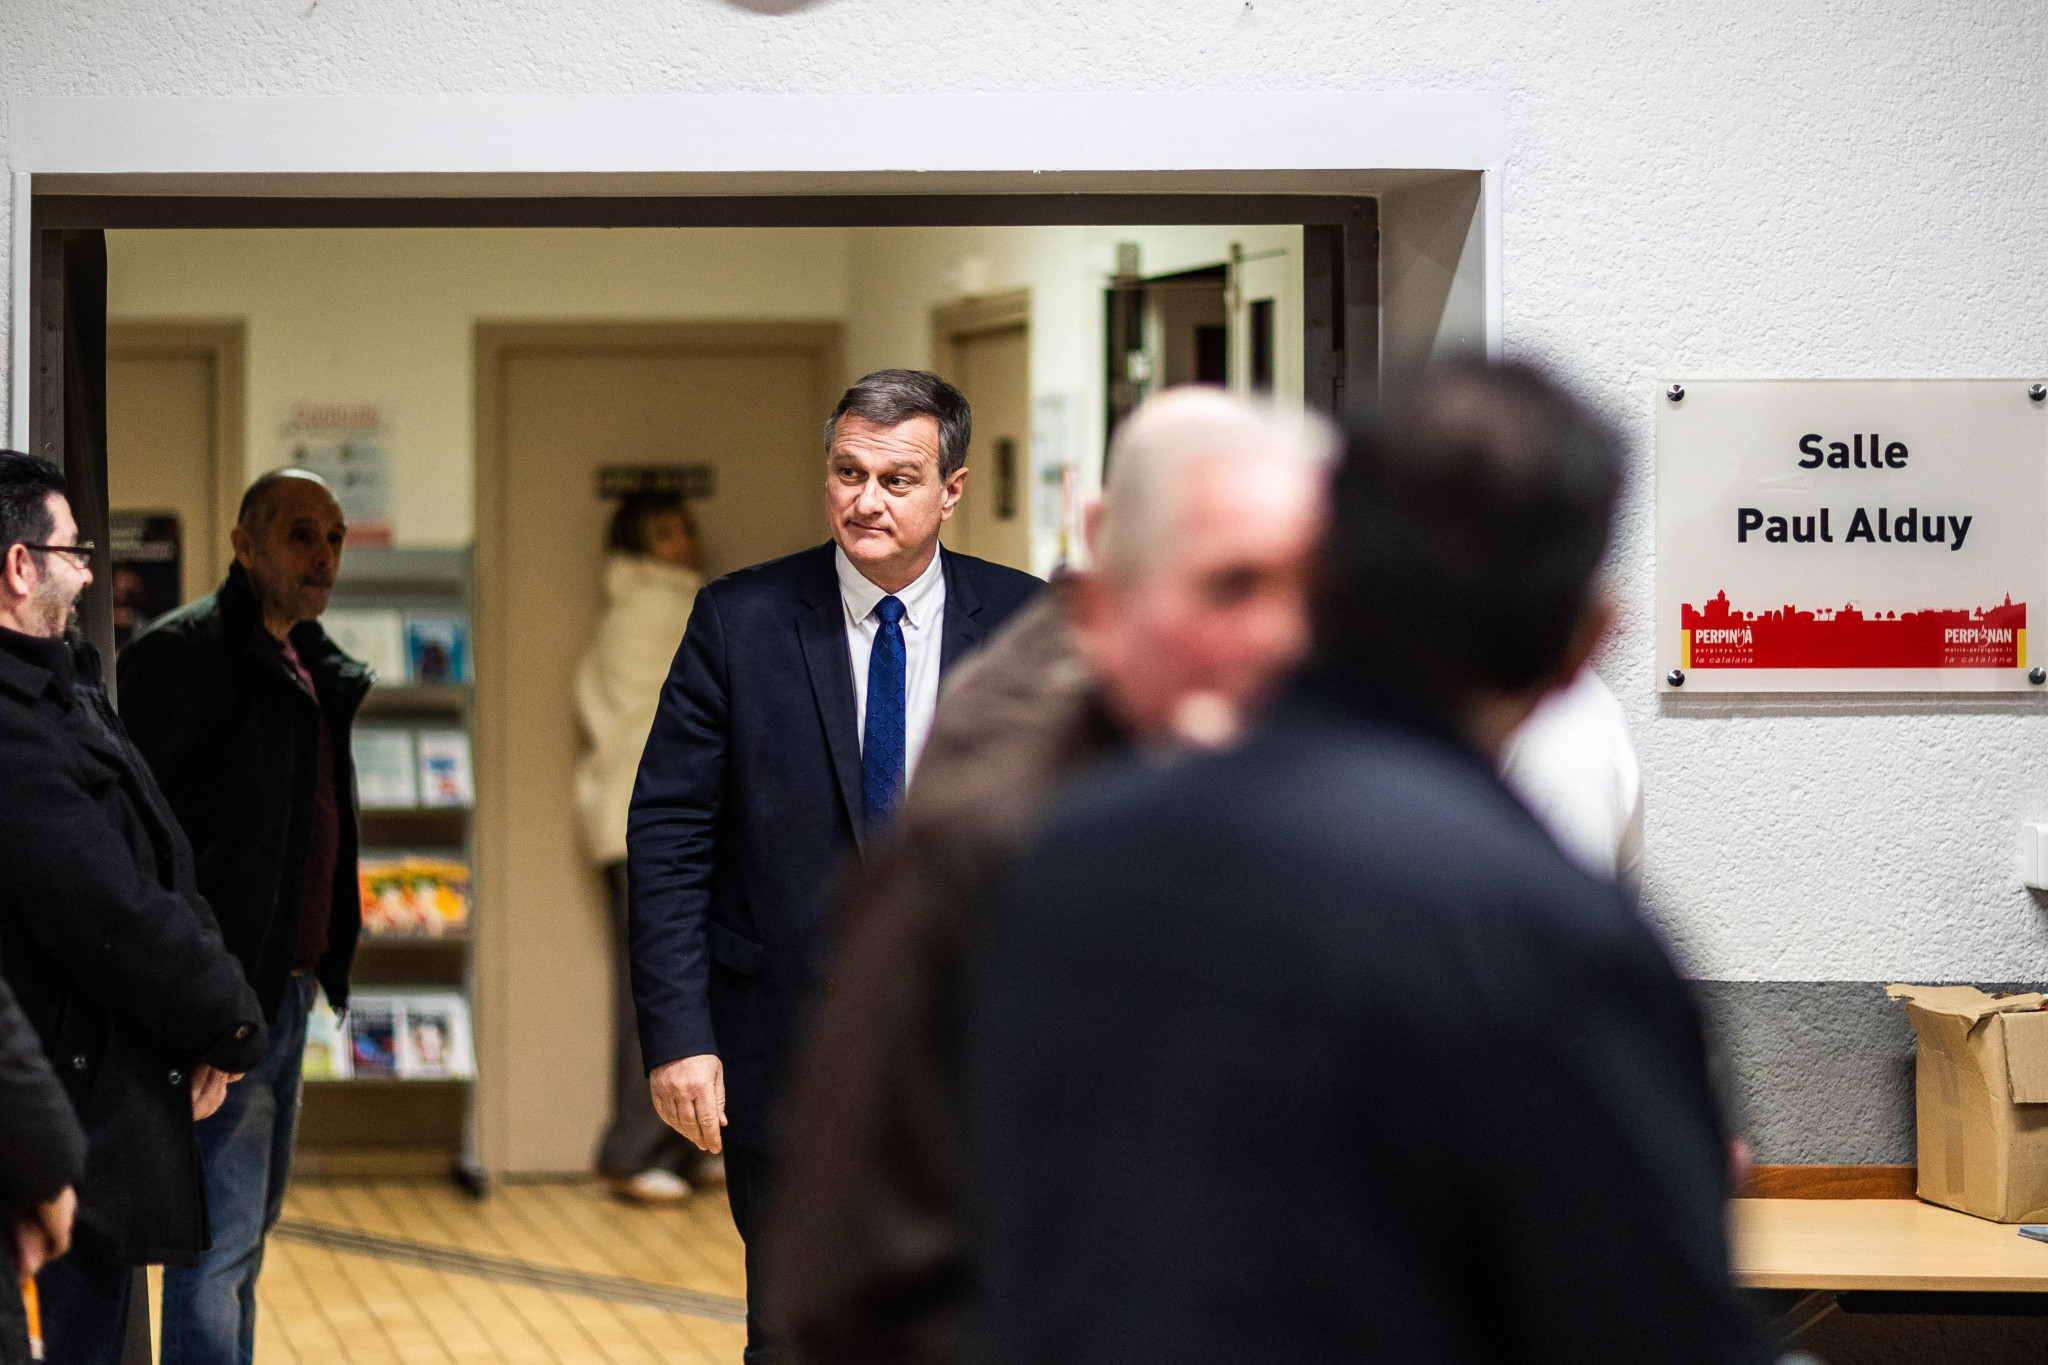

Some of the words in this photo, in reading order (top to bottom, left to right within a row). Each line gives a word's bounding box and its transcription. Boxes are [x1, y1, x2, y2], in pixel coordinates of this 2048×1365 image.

[1798, 433, 1909, 469] Salle
[1737, 507, 1833, 543] Paul
[1845, 507, 1973, 551] Alduy
[1944, 624, 2012, 648] PERPIGNAN
[1945, 655, 1955, 663] la
[1961, 655, 2012, 663] catalane
